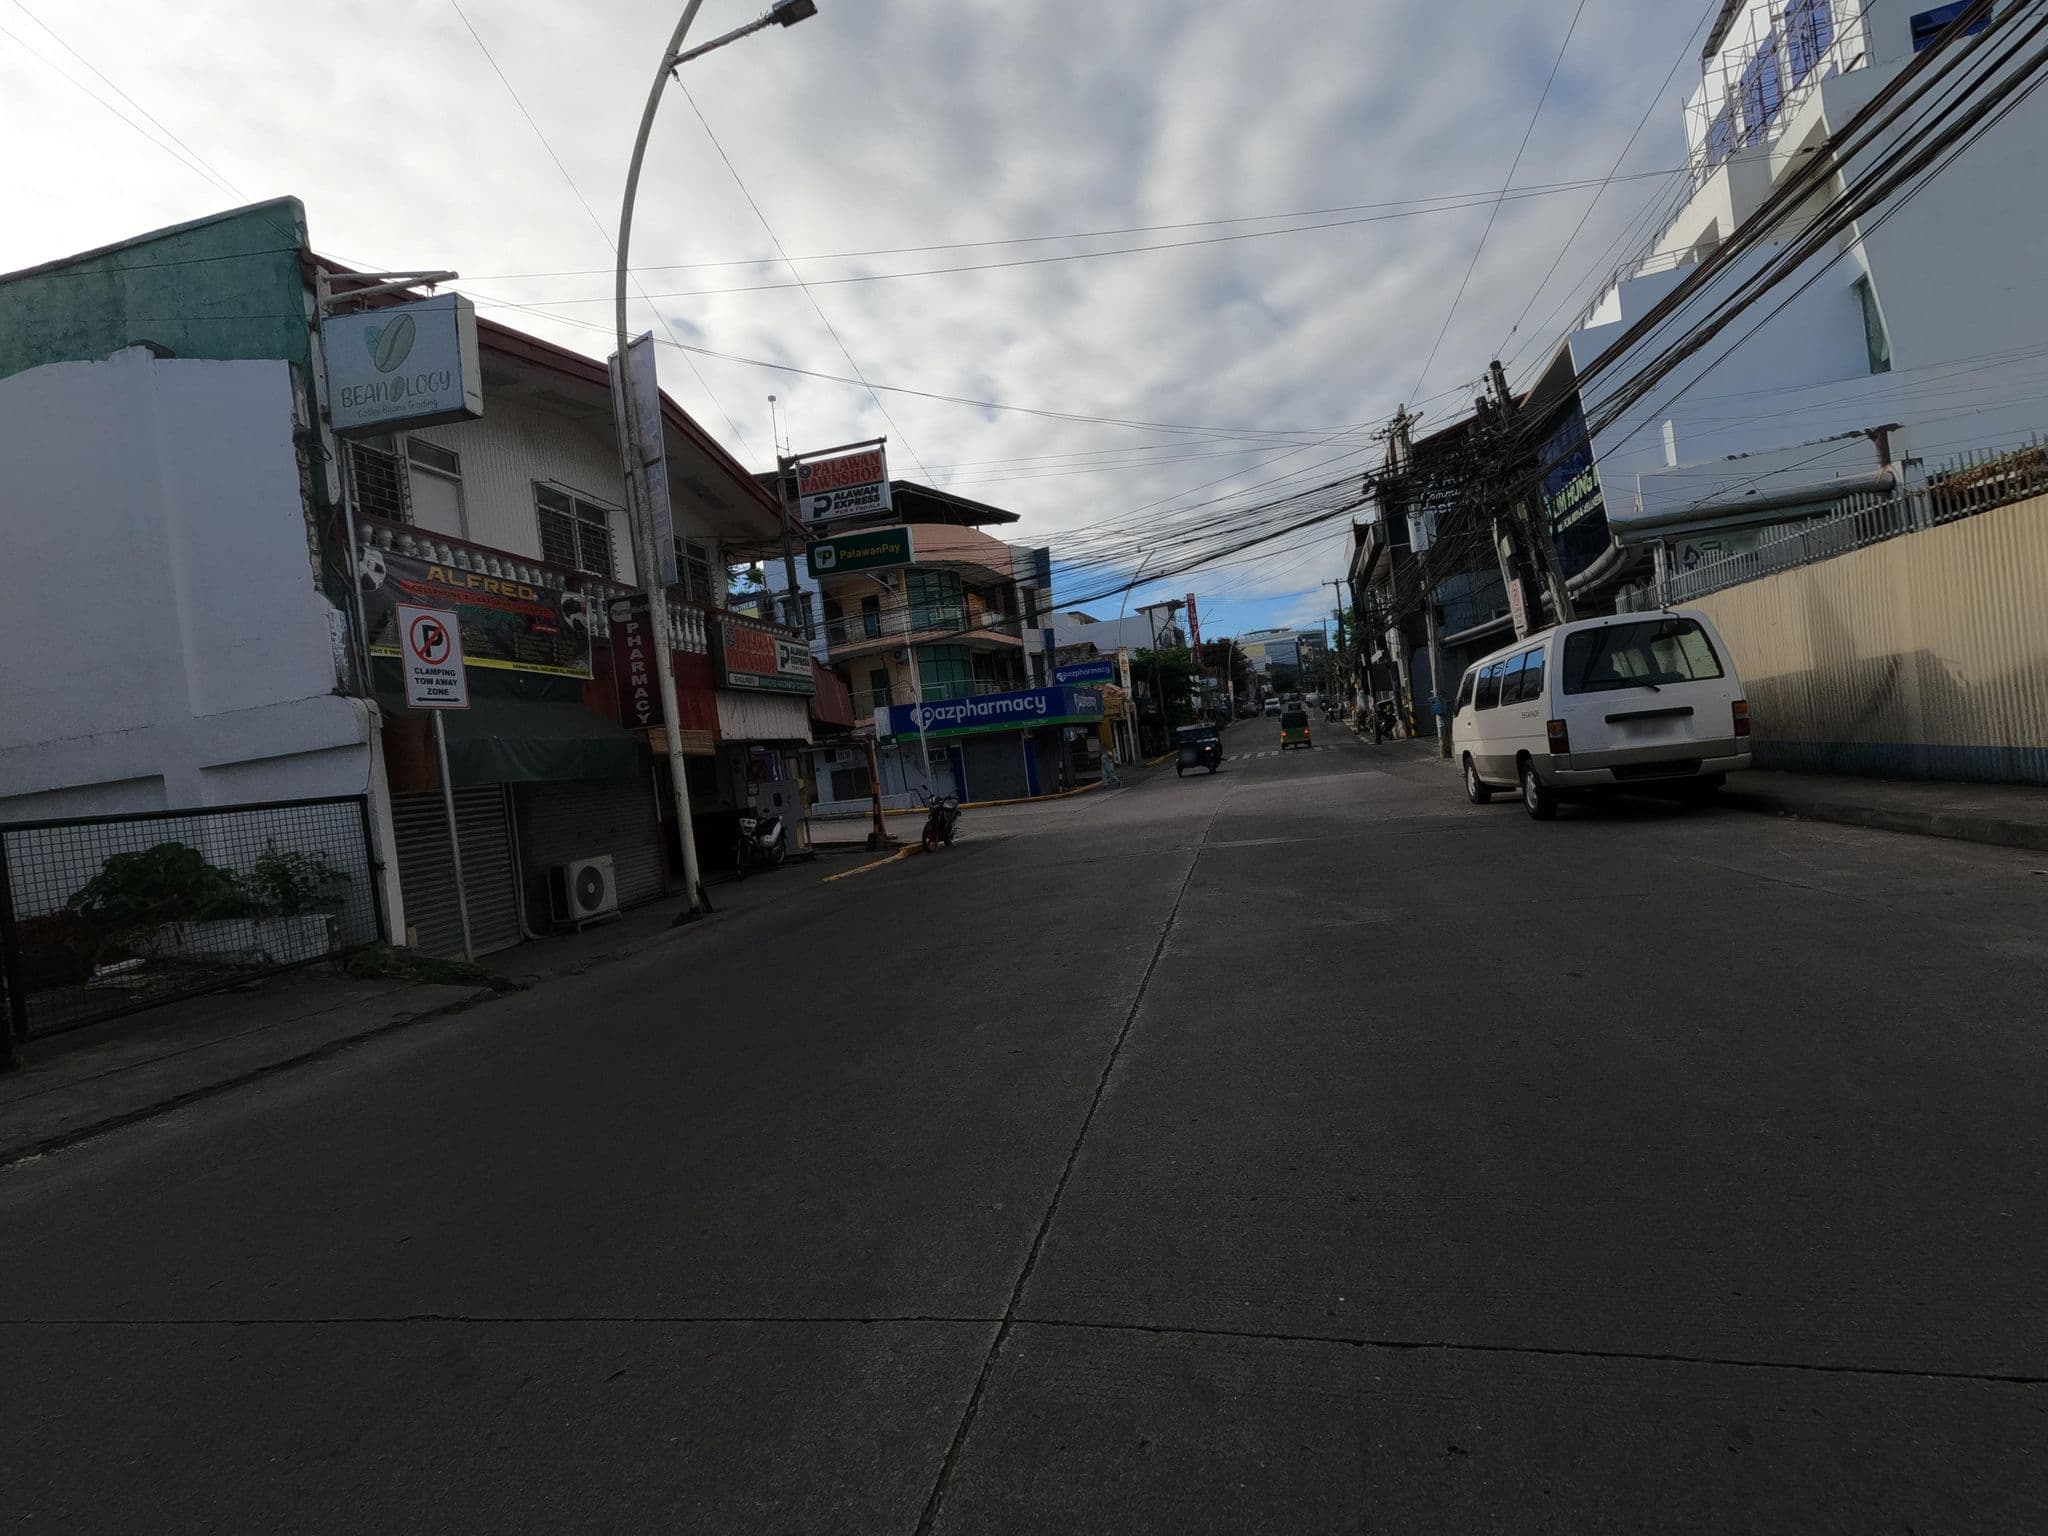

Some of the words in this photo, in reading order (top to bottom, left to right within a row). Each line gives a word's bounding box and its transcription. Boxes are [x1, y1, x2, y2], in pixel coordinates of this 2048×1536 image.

[812, 451, 880, 477] PALAWAN
[800, 465, 881, 493] PAWNSHOP
[834, 494, 881, 510] EXPRESS
[839, 543, 900, 560] PalawanPay
[426, 564, 537, 601] ALFRED
[414, 667, 457, 677] CLAMPING
[626, 622, 651, 725] PHARMACY
[415, 677, 435, 686] TOW
[435, 678, 458, 687] AWAY
[427, 688, 450, 696] ZONE
